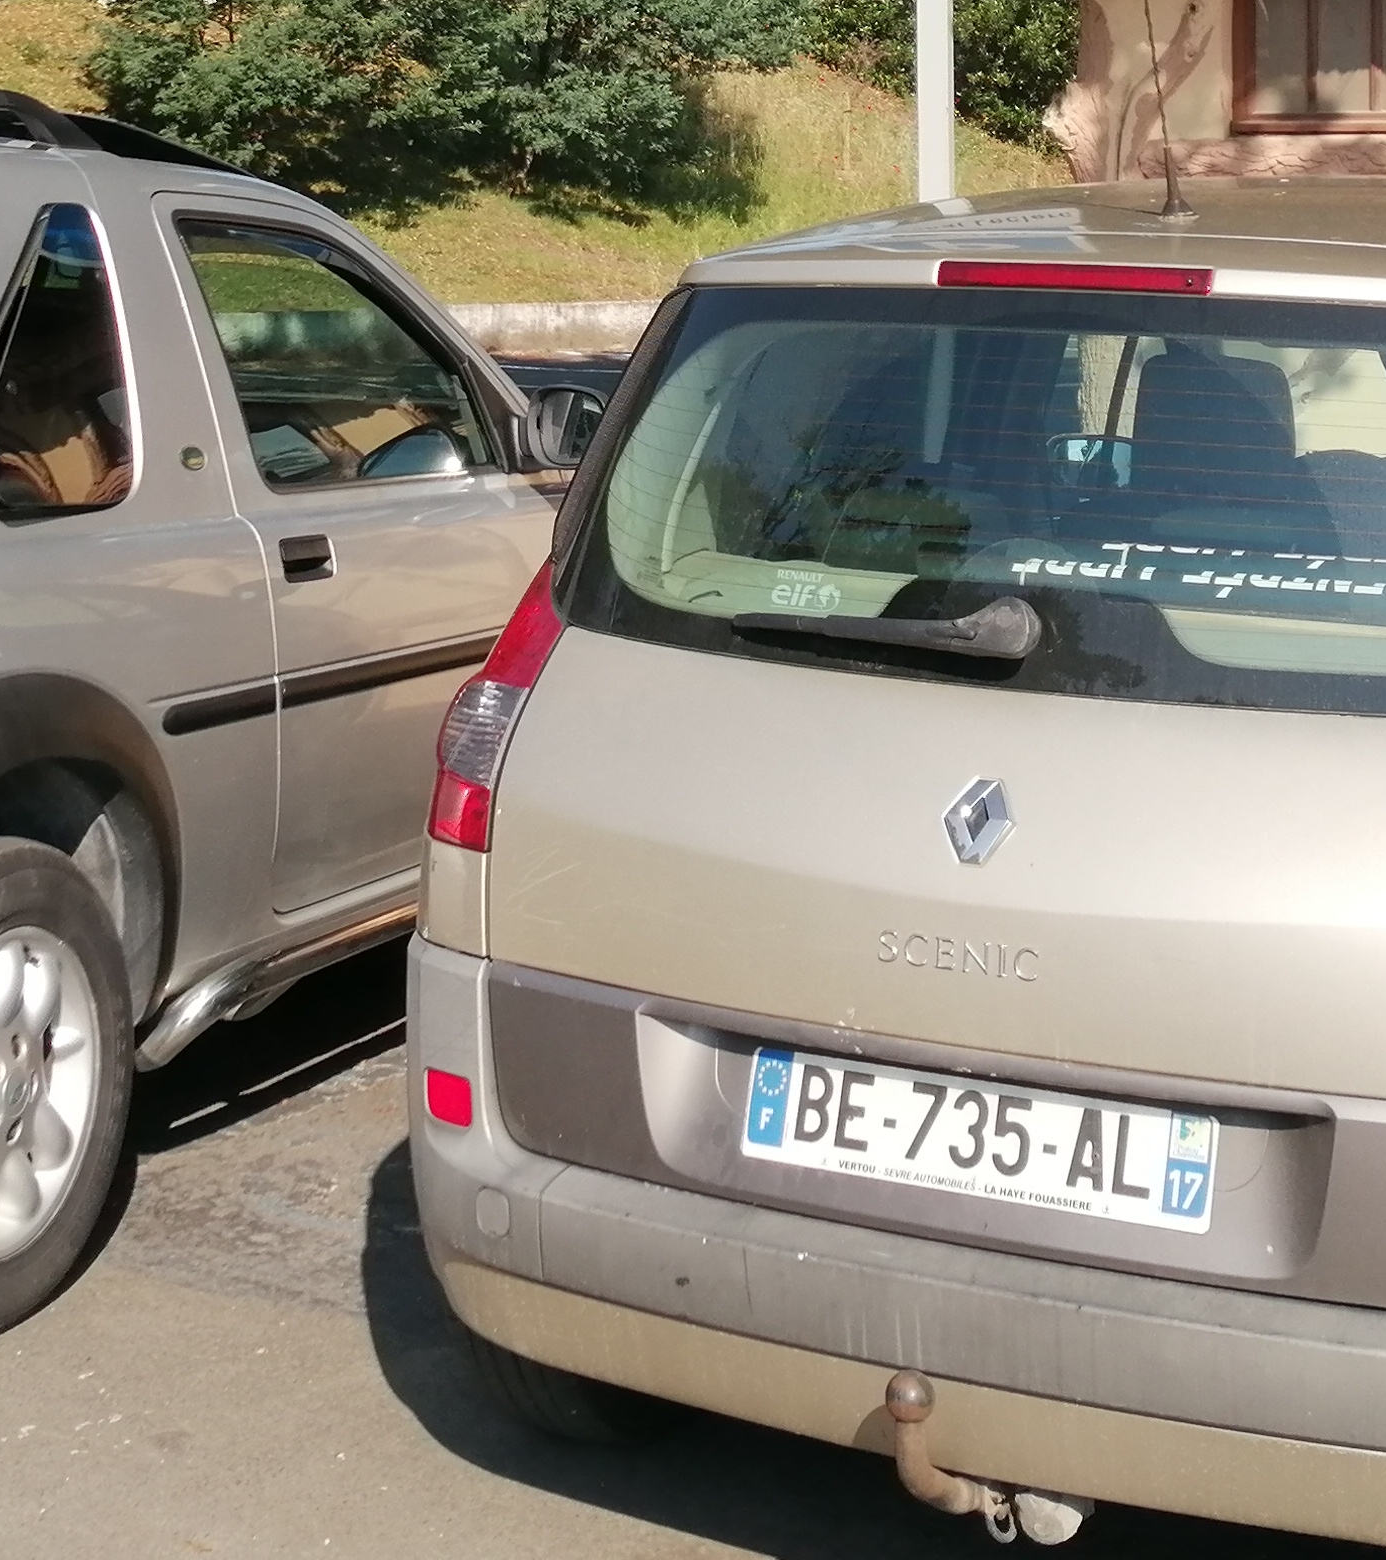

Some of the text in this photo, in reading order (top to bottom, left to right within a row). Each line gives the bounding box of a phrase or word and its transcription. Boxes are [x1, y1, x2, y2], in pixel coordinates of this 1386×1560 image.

[771, 583, 816, 607] elf
[777, 569, 825, 583] RENAULT
[877, 929, 1039, 982] SCENIC
[759, 1108, 773, 1130] F
[794, 1064, 1150, 1200] BE-735-AL
[838, 1160, 876, 1174] VERTOU
[884, 1167, 911, 1181] SEVRE
[913, 1173, 976, 1191] AUTOMOBILES
[984, 1184, 997, 1195] LA
[999, 1187, 1026, 1200] HAYE
[1029, 1192, 1092, 1211] FOUASSIERE
[1169, 1168, 1204, 1210] 17
